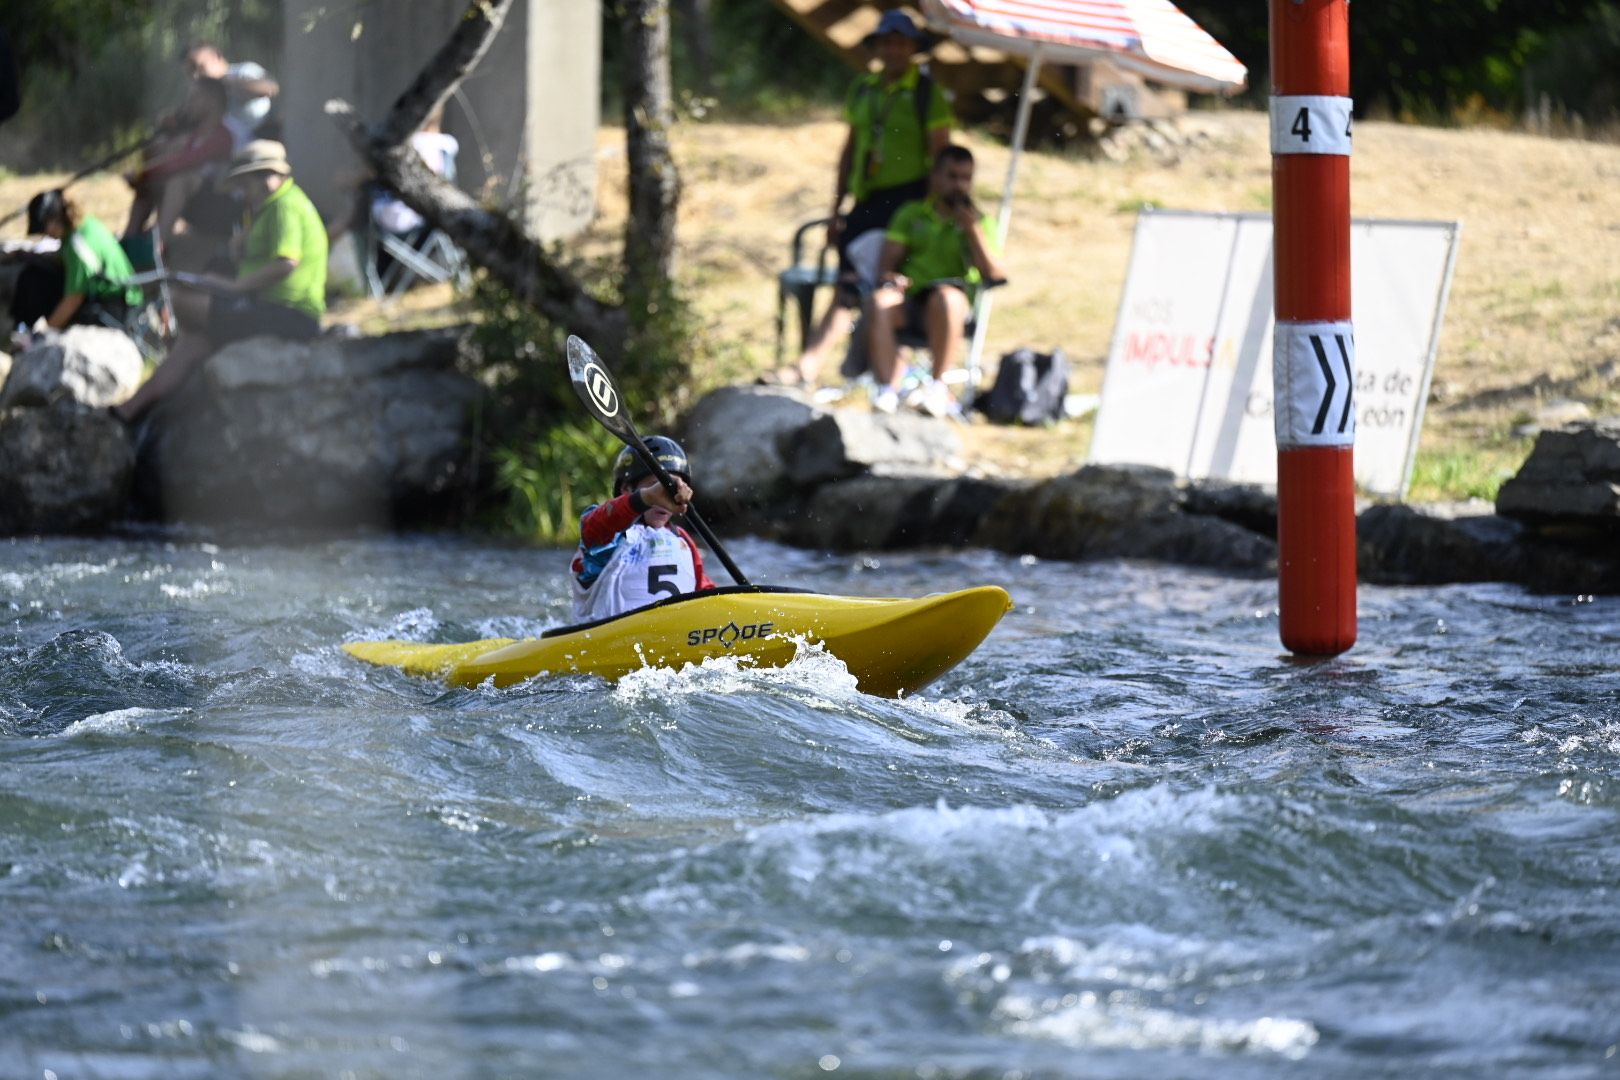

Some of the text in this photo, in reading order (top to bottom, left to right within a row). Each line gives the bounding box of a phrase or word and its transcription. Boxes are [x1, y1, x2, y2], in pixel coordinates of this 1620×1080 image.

[1291, 107, 1312, 142] 4
[1384, 369, 1412, 395] de
[647, 564, 680, 597] 5
